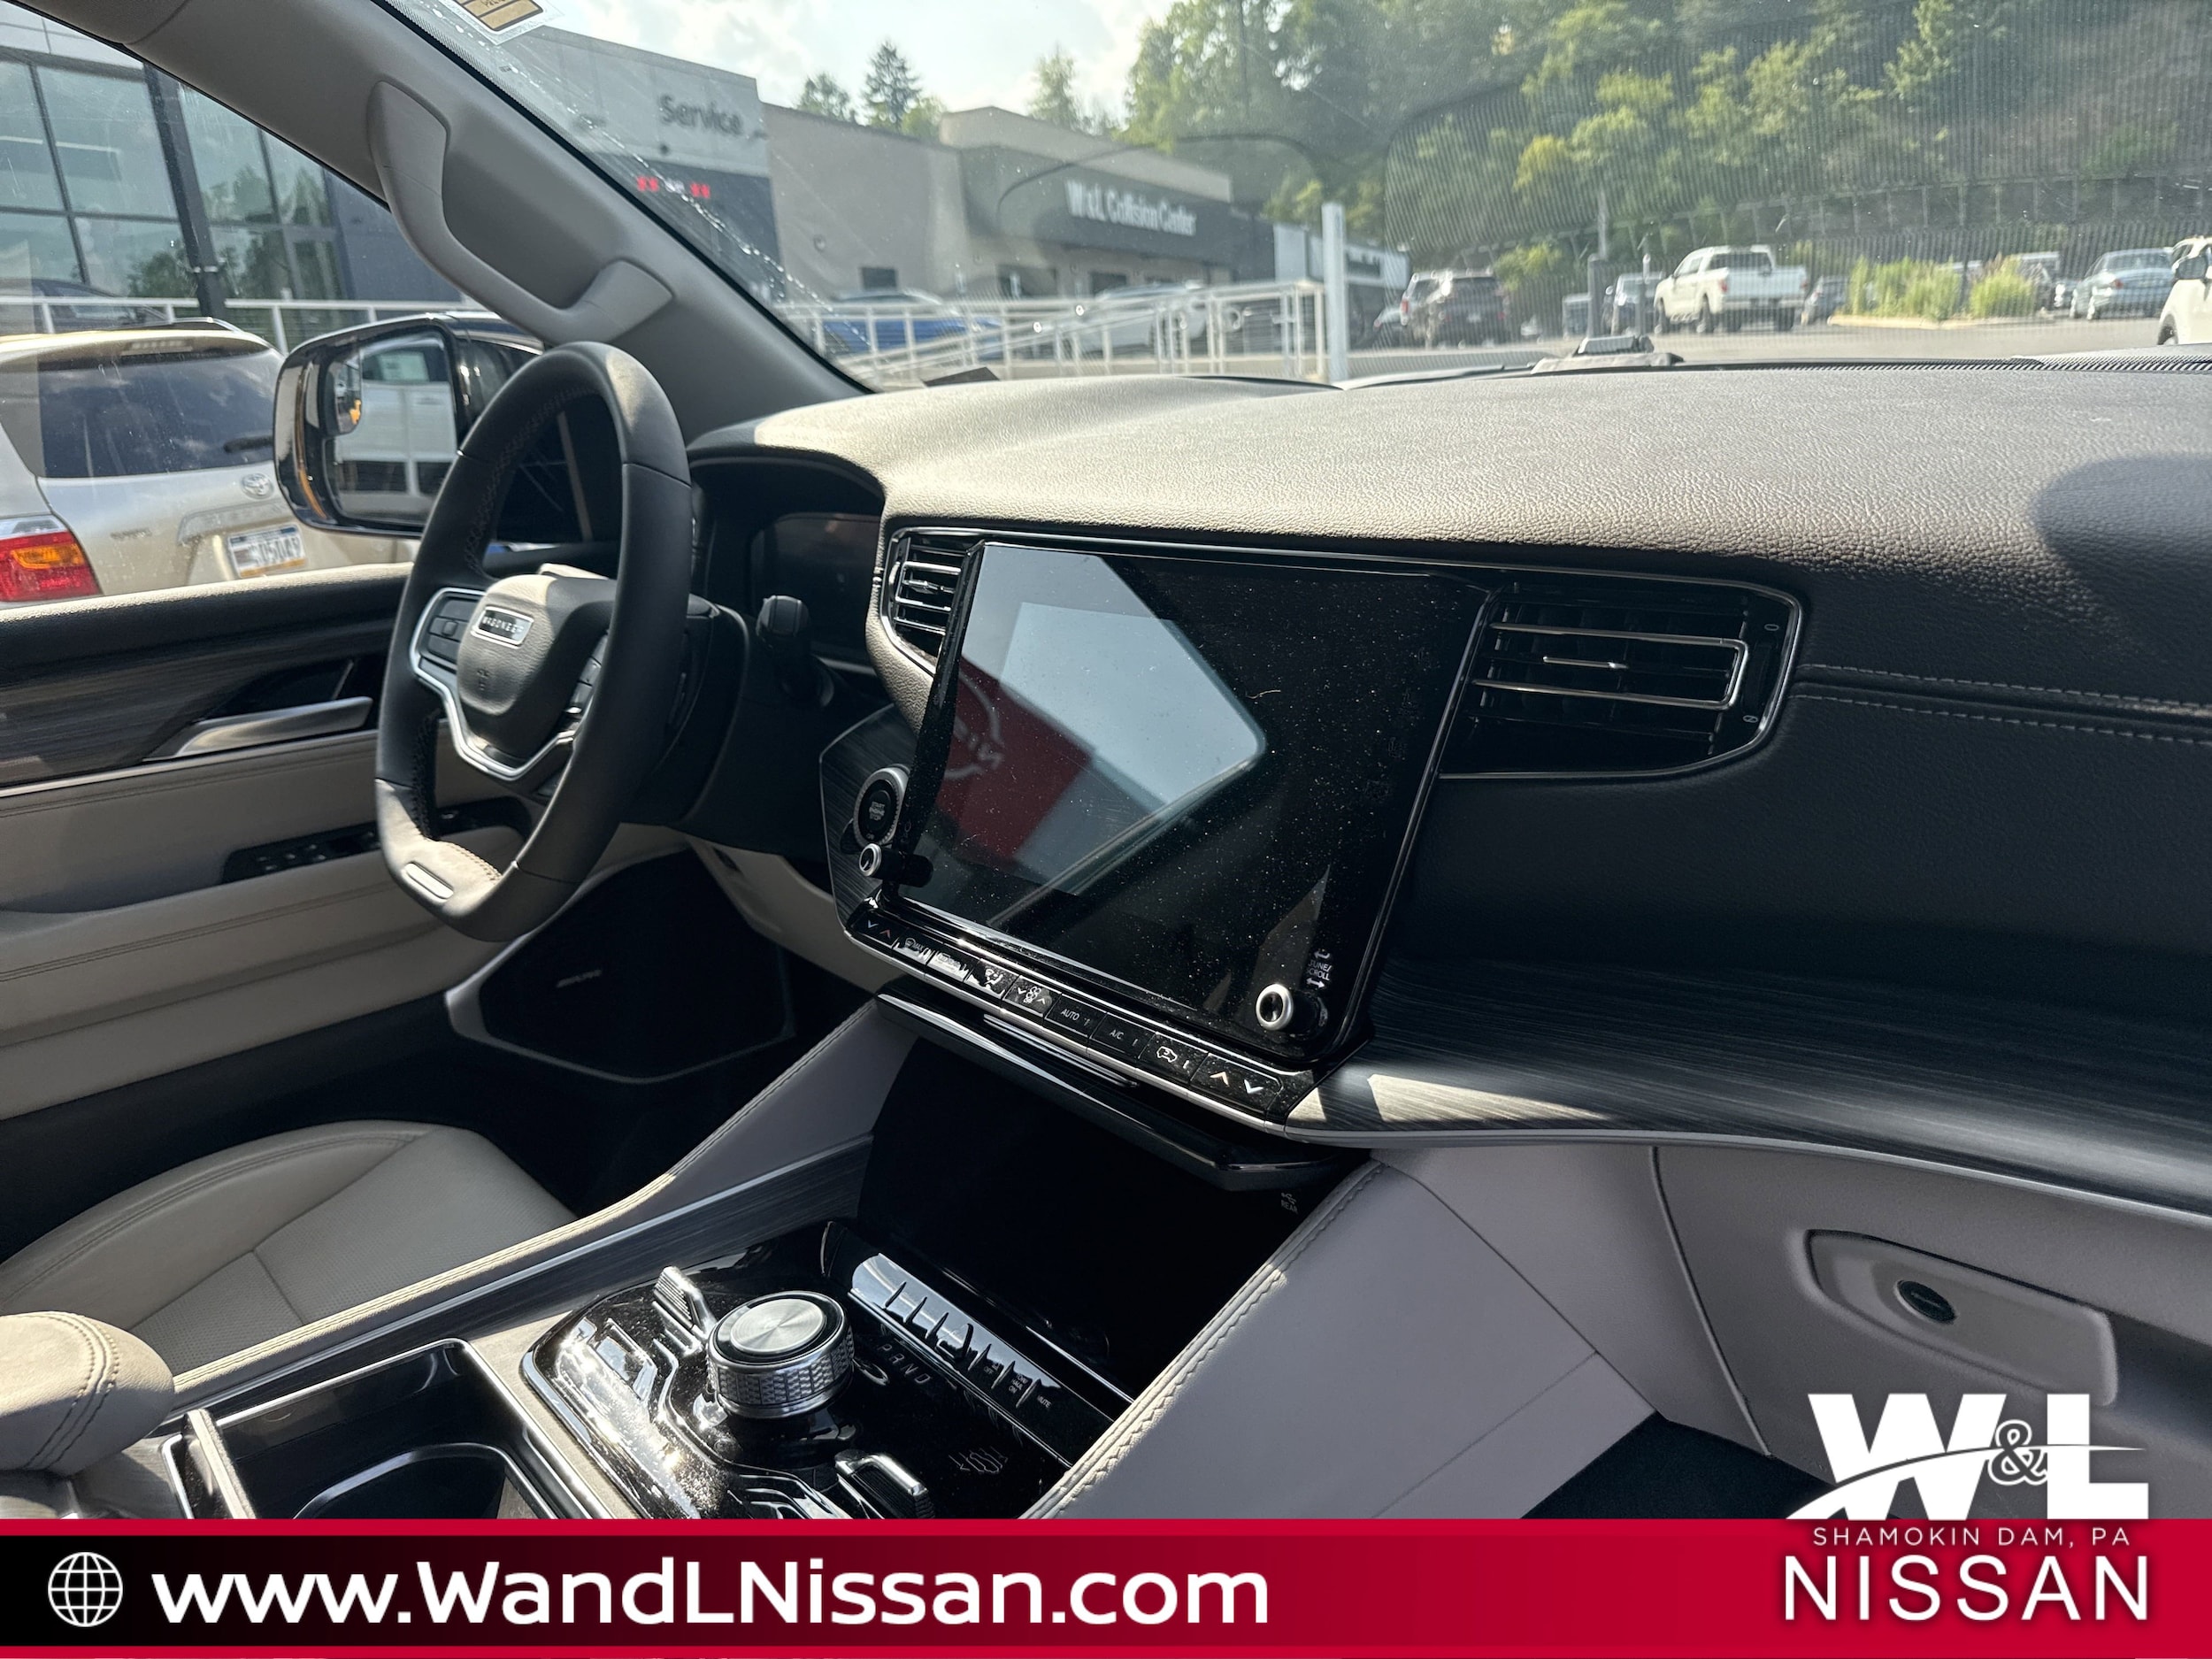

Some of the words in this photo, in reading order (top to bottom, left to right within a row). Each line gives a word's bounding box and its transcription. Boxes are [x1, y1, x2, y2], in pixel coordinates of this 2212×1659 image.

[659, 95, 743, 135] Service
[1107, 188, 1159, 230] Collision
[1159, 199, 1196, 236] Center
[1061, 1009, 1079, 1021] AUTO
[1110, 1029, 1125, 1040] A/C
